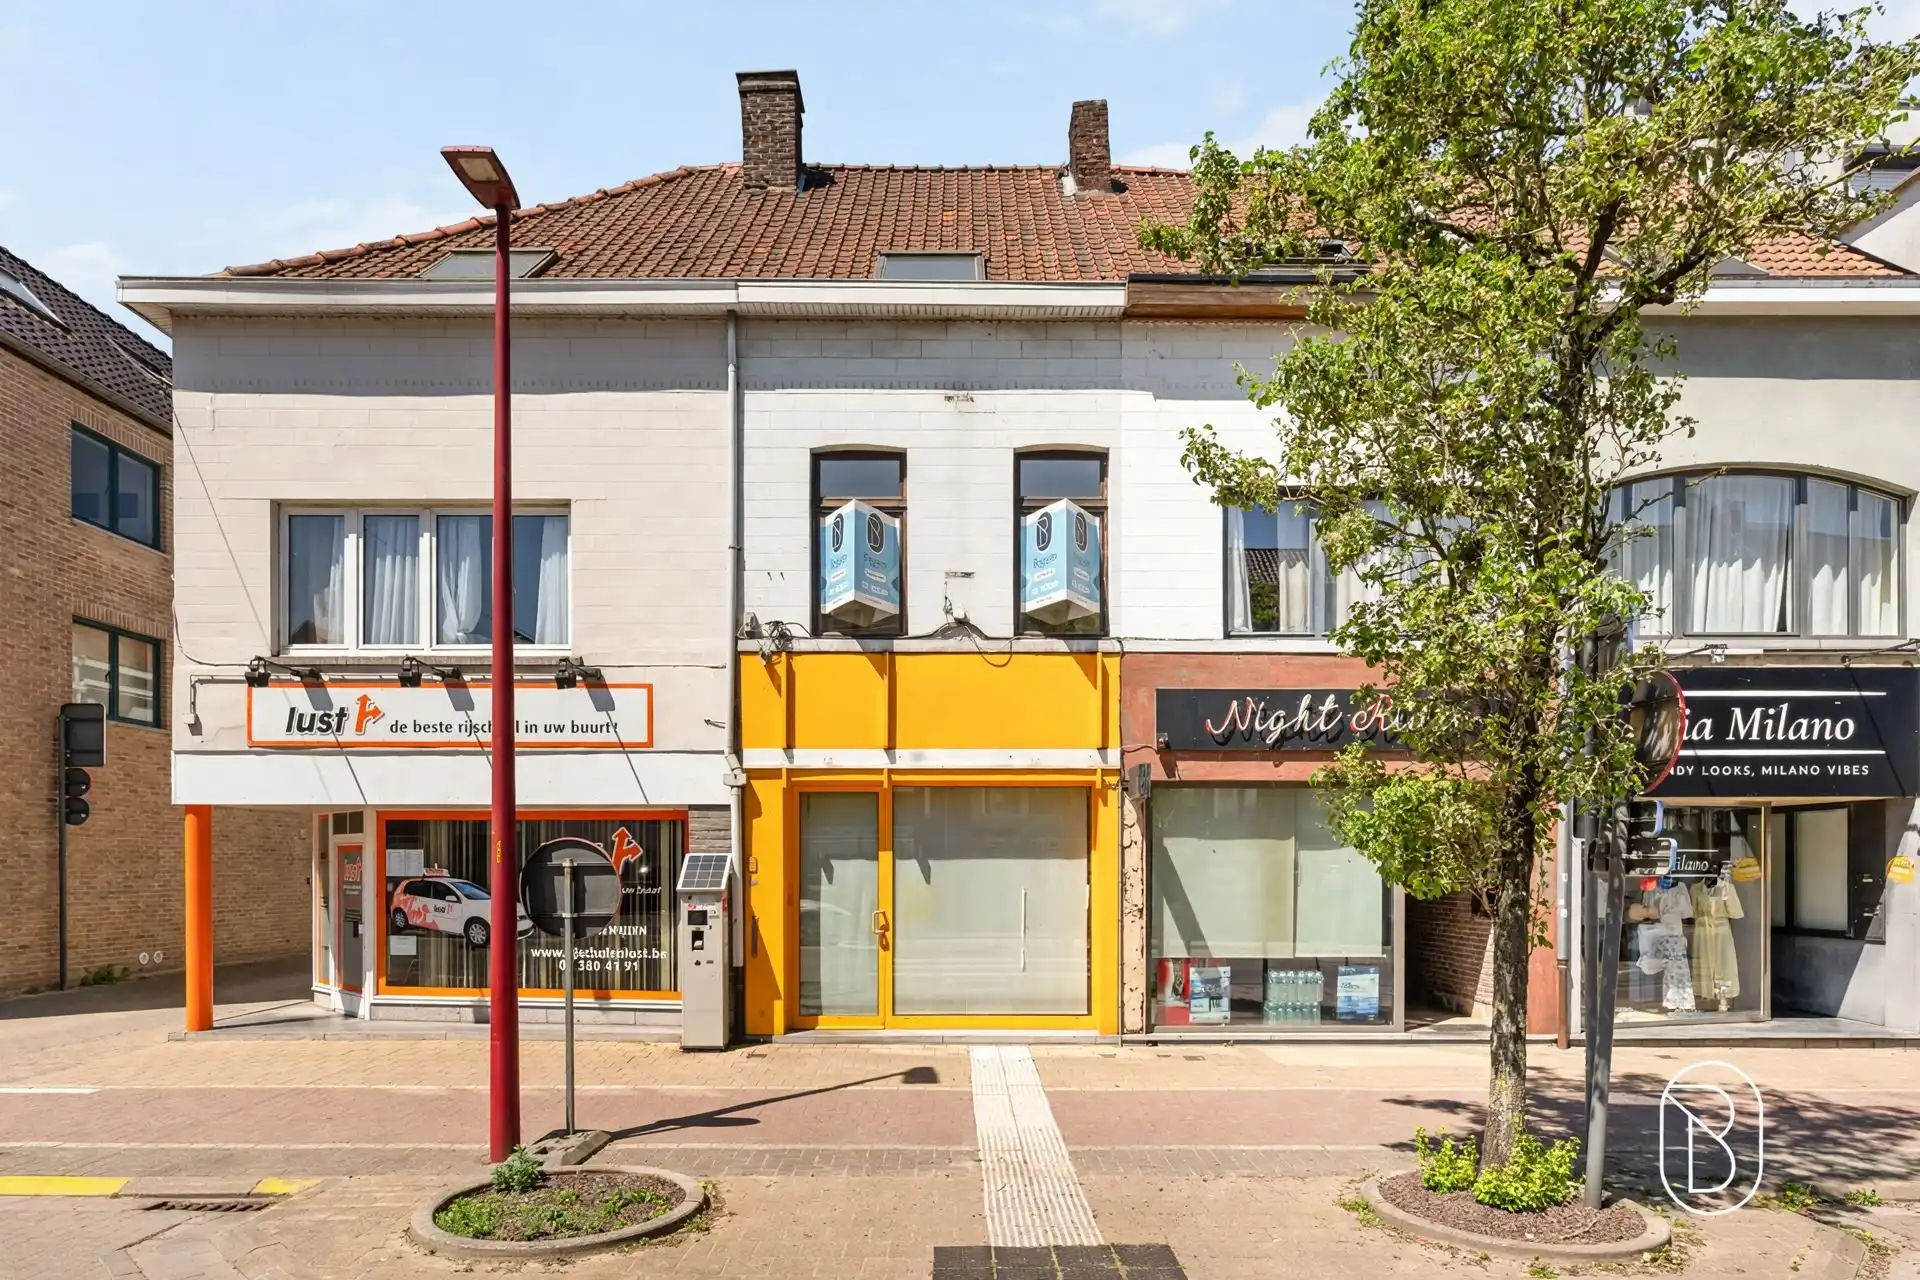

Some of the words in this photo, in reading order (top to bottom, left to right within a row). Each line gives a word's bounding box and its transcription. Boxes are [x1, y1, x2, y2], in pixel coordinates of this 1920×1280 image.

[284, 706, 348, 734] lust
[389, 719, 408, 734] de
[413, 719, 454, 734] beste
[458, 719, 520, 737] rijschl
[524, 719, 538, 734] in
[543, 722, 566, 734] uw
[1203, 694, 1342, 744] Night
[1682, 708, 1715, 741] ia
[1726, 703, 1856, 741] Milano
[1701, 764, 1756, 778] LOOKS,
[1761, 764, 1820, 776] MILANO
[1826, 764, 1870, 776] VIBES
[577, 959, 601, 971] 380
[605, 959, 620, 971] 41
[624, 959, 639, 971] 91
